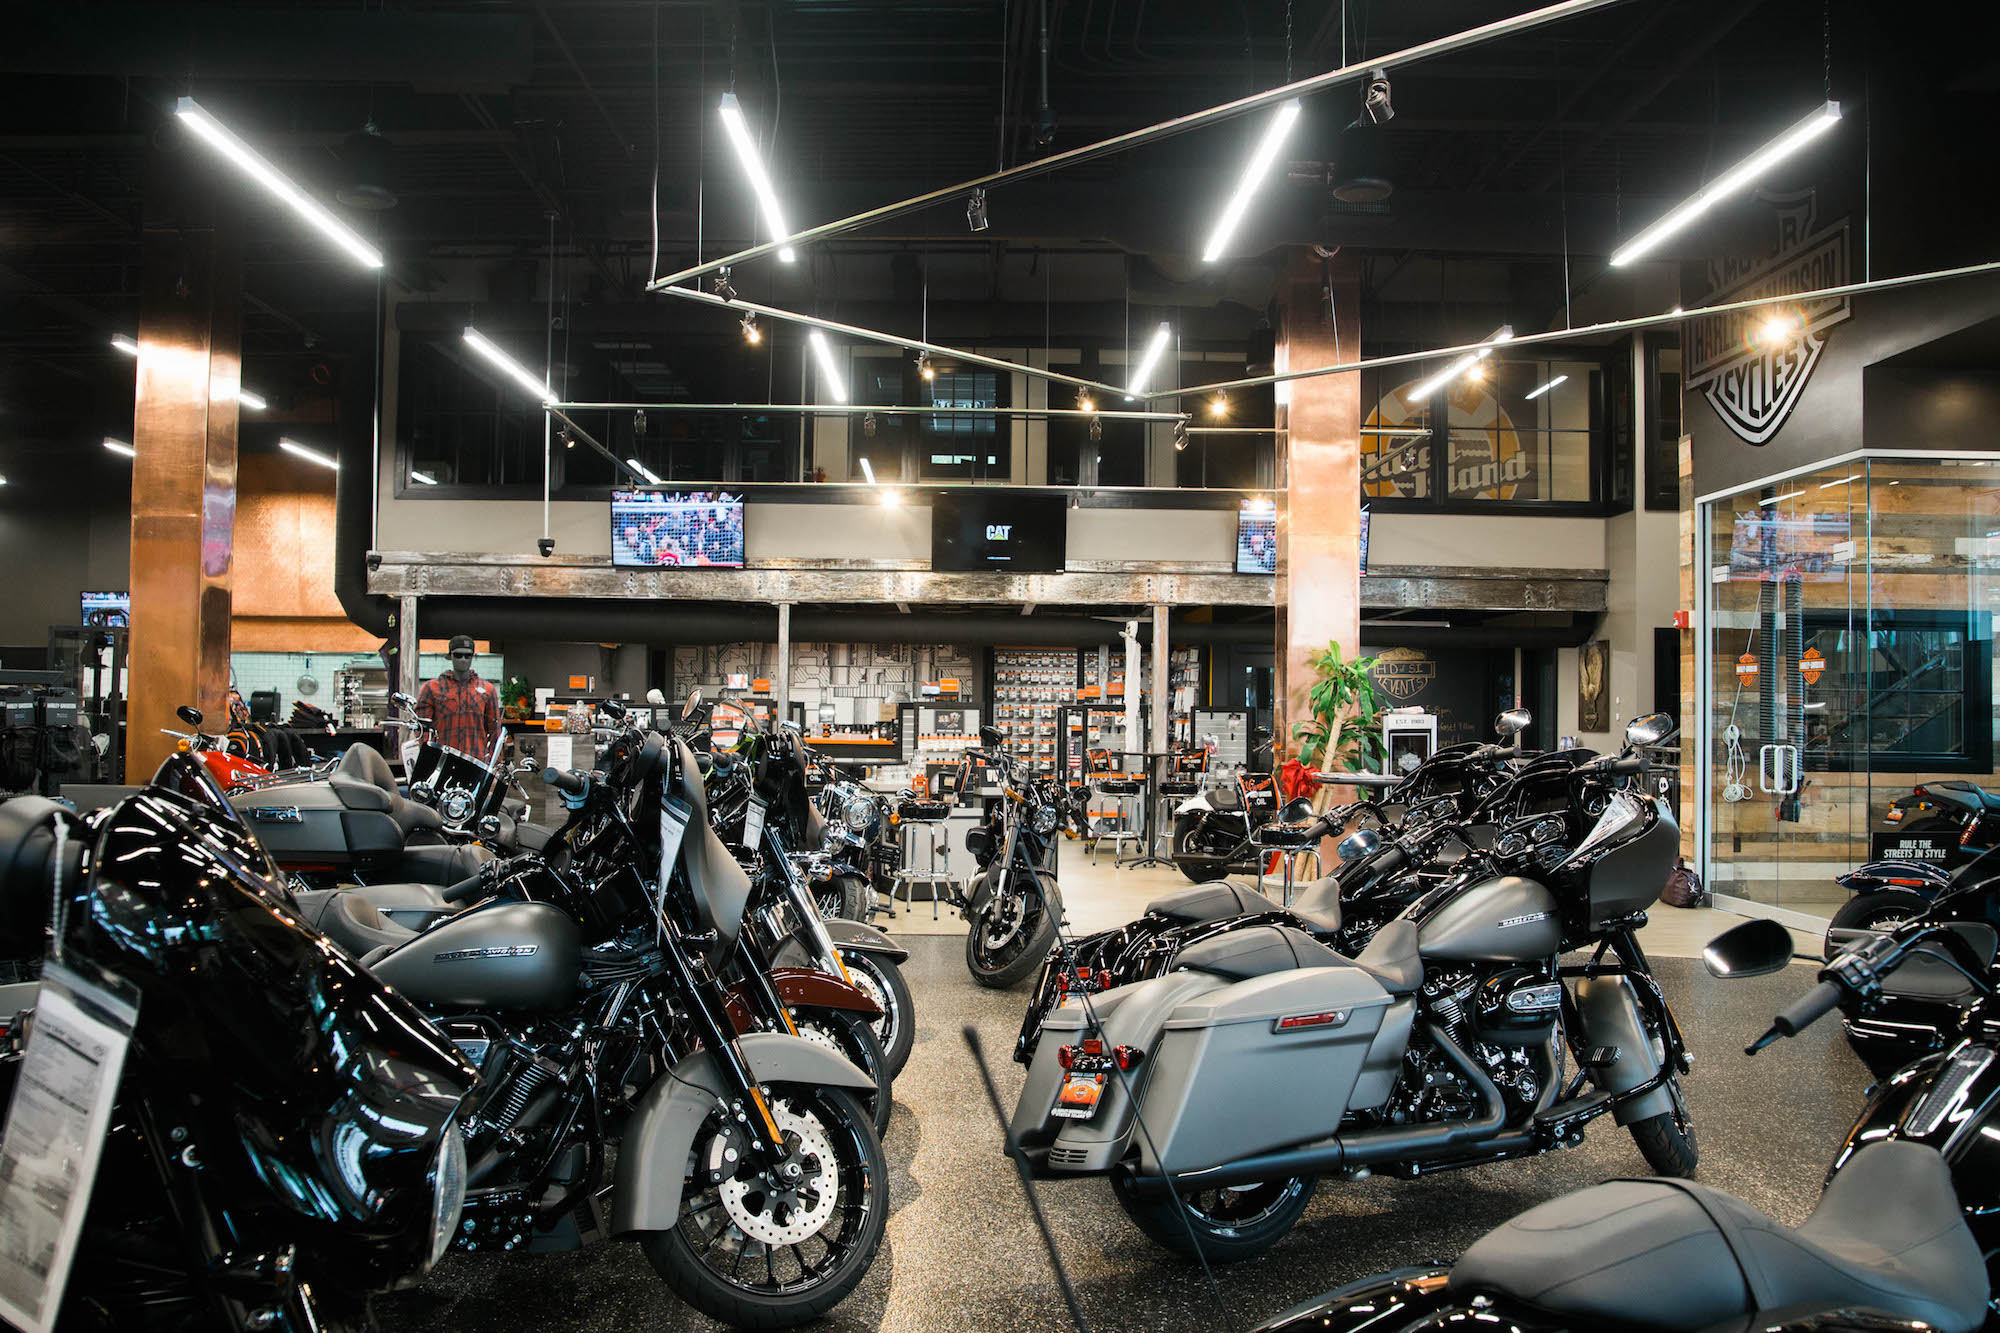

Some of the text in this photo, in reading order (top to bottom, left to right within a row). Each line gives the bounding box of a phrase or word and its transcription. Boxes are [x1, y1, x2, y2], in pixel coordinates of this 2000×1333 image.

[1695, 249, 1836, 364] HARLEAVIDSON
[1724, 340, 1799, 420] CYCLES
[1411, 451, 1530, 497] Iland
[986, 525, 1012, 541] CAT
[1381, 678, 1424, 696] EVENTS
[1256, 798, 1267, 806] OIL
[1899, 839, 1932, 849] RULE THE
[1884, 849, 1946, 859] STREETS IN STYLE
